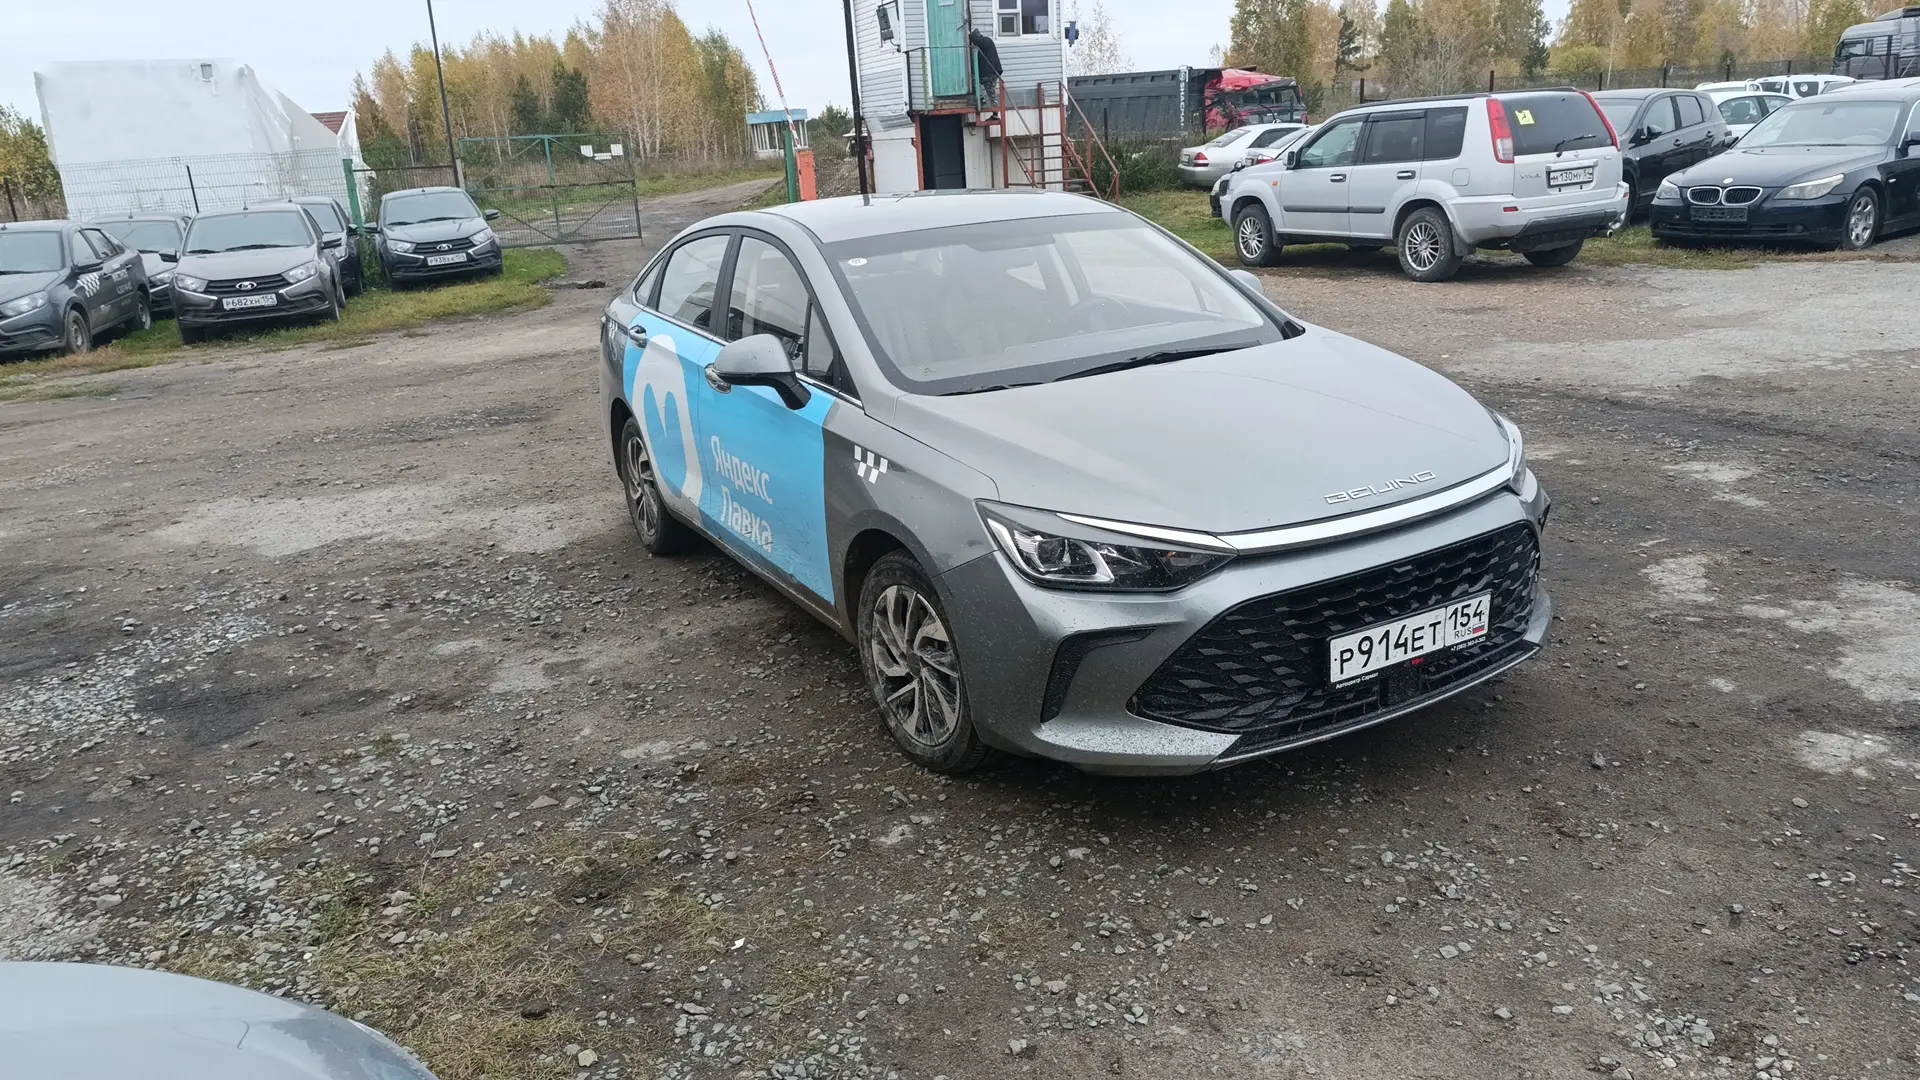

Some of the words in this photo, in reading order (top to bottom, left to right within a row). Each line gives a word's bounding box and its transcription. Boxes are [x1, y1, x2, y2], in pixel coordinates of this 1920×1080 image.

[226, 298, 260, 307] Р682ХН
[711, 435, 773, 505] Яндекс
[1323, 470, 1437, 505] BEIJING
[720, 484, 773, 553] Лавка
[1340, 620, 1441, 675] Р914ЕТ
[1448, 600, 1483, 630] 154
[1454, 626, 1472, 640] RUS
